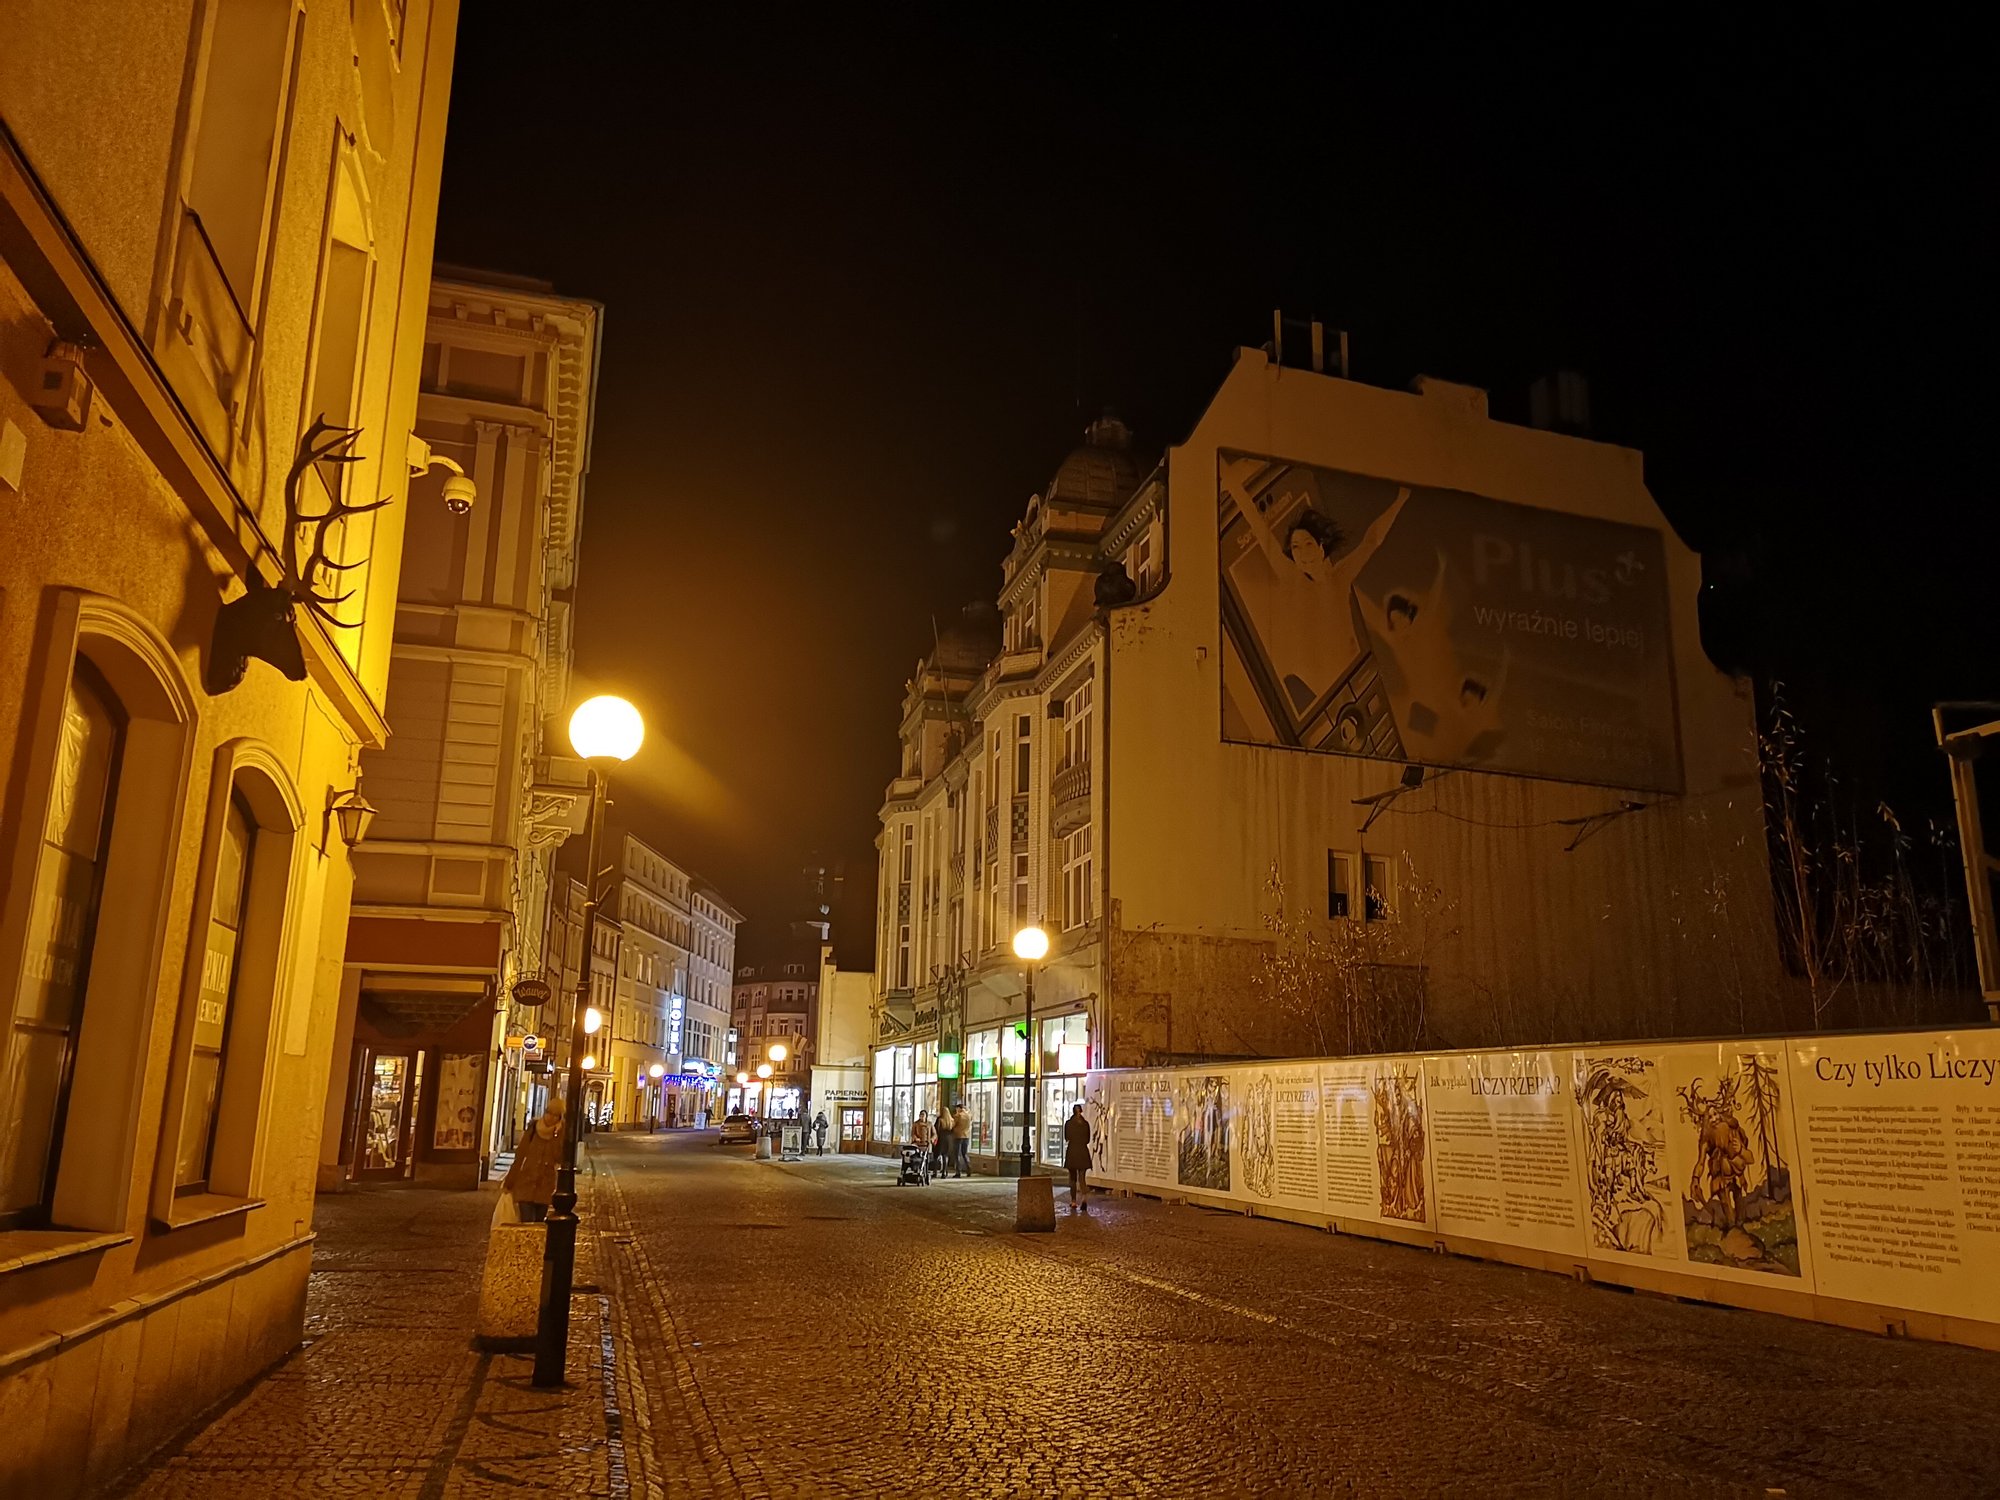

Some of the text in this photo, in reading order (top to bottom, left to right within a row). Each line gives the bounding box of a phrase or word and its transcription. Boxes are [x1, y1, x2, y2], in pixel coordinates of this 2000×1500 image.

[1472, 533, 1612, 604] Plus
[1585, 616, 1645, 656] lepiej
[518, 986, 549, 999] Wawel
[669, 998, 682, 1055] HOTEL
[1815, 1051, 2000, 1087] Czy tylko Liczy
[824, 1089, 869, 1097] PAPIERNIA
[1276, 1090, 1316, 1103] LICZYRZEPA
[1470, 1076, 1562, 1096] LICZYRZEPA?
